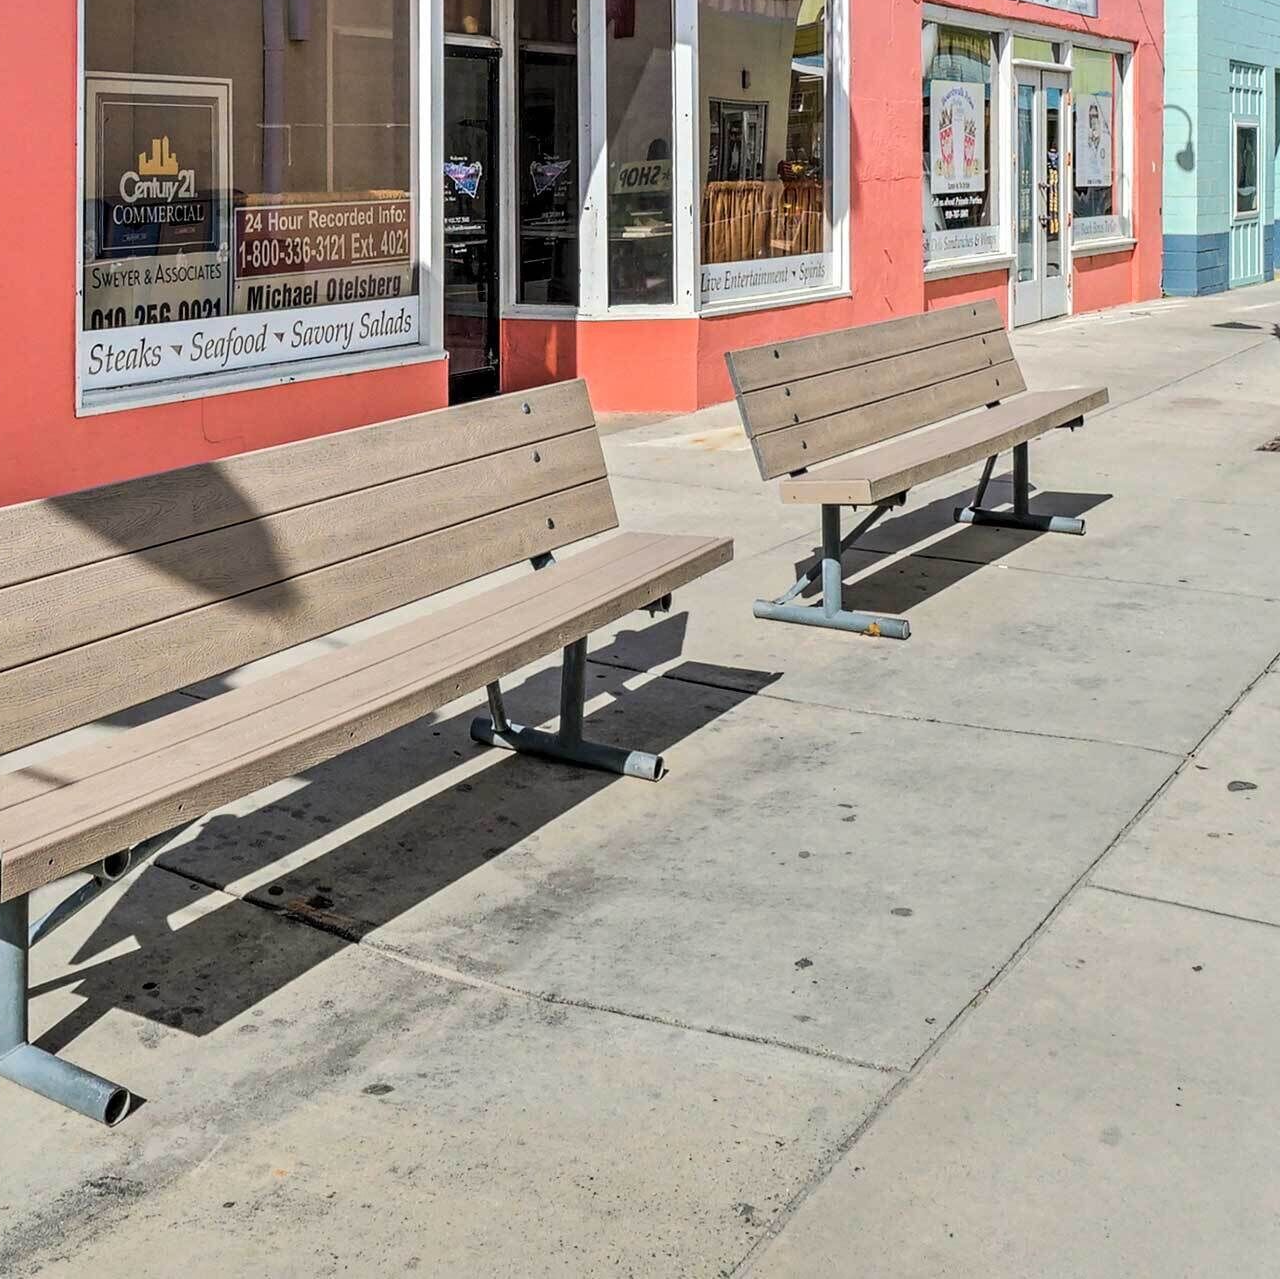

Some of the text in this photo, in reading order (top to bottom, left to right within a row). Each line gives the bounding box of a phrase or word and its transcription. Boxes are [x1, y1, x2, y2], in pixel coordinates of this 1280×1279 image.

[120, 171, 179, 203] Century
[113, 204, 204, 225] COMMERCIAL
[244, 204, 406, 233] 24 Hour Recorded Info:
[239, 229, 409, 269] 1-800-336-3121 Ext. 4021
[92, 263, 221, 289] SWEYER & ASSOCIATES
[701, 261, 826, 293] Live Entertainment Spirits
[247, 274, 402, 312] Michael Otelsberg
[88, 307, 412, 375] Steaks Seafood Savory Salads
